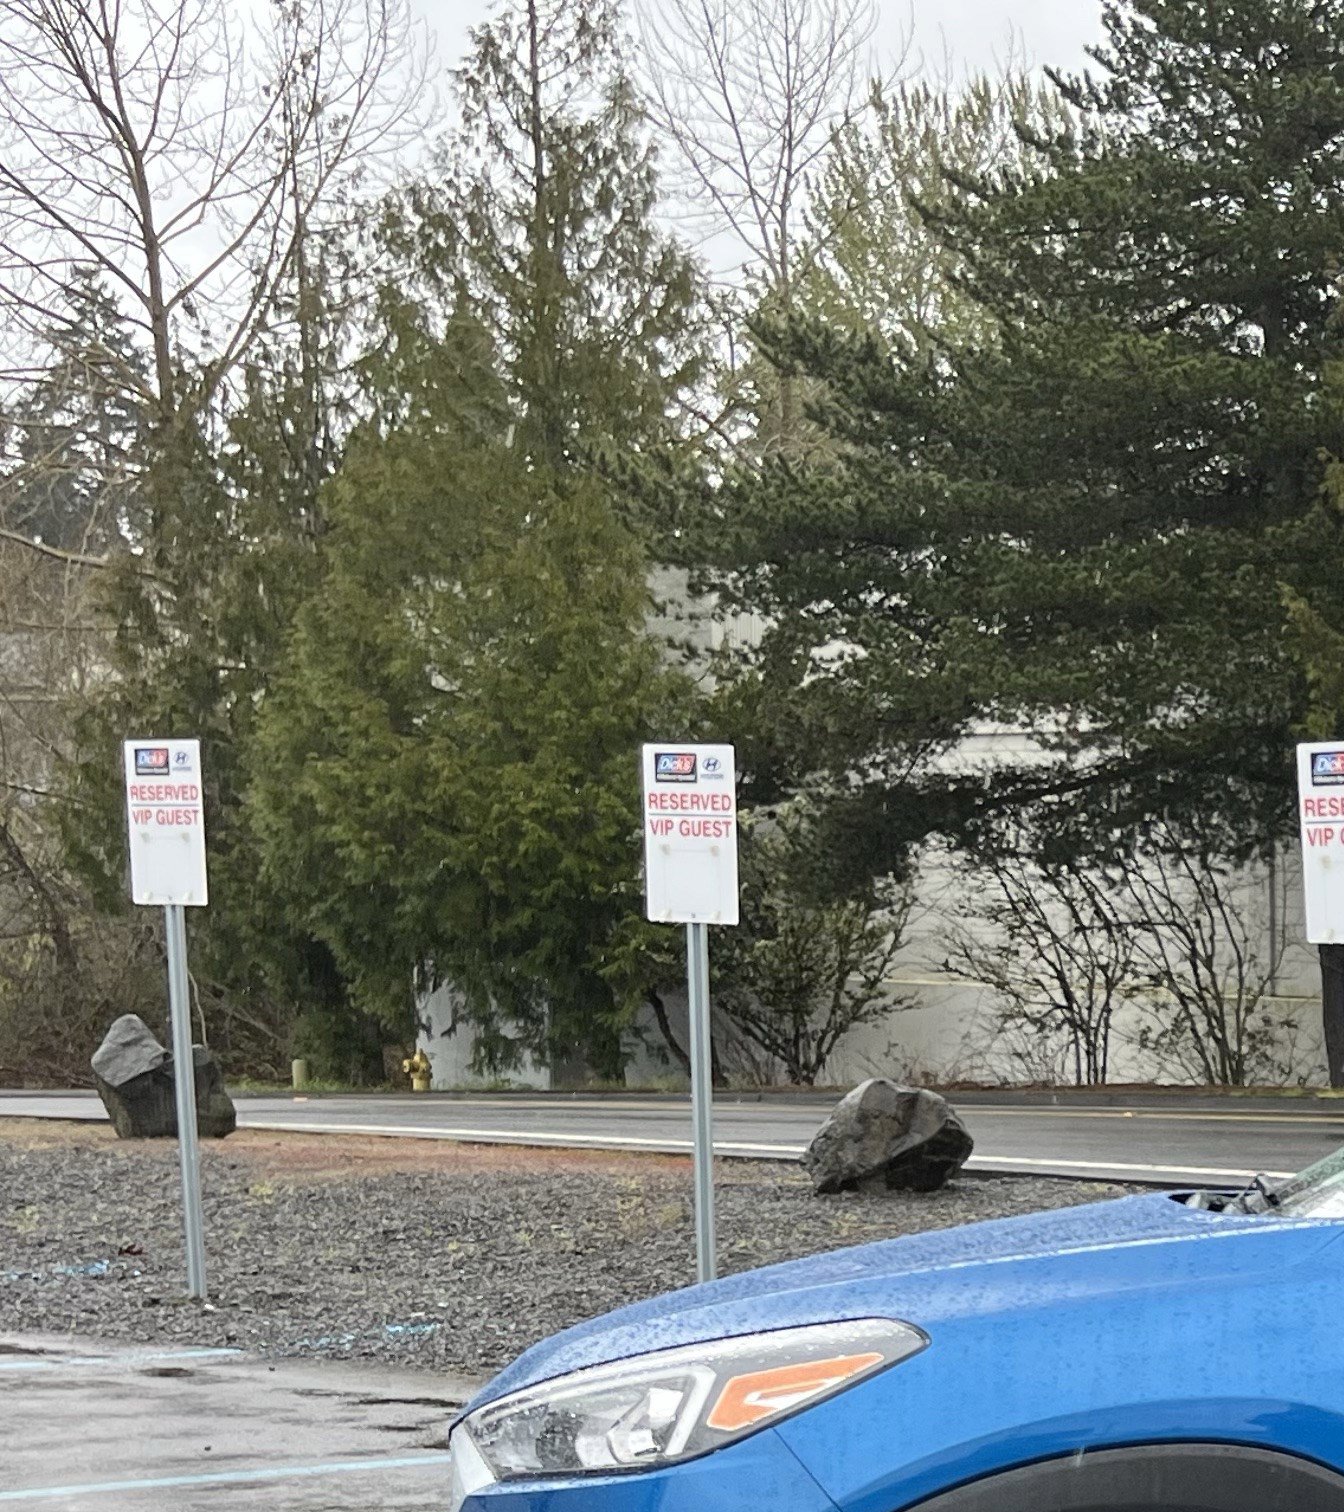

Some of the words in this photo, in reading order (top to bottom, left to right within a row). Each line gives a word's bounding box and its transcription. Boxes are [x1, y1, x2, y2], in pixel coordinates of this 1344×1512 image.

[130, 784, 199, 801] RESERVED
[648, 793, 732, 812] RESERVED
[132, 810, 153, 825] VIP
[156, 810, 199, 825] GUEST
[650, 820, 674, 836] VIP
[679, 820, 732, 838] GUEST
[1306, 827, 1334, 847] VIP
